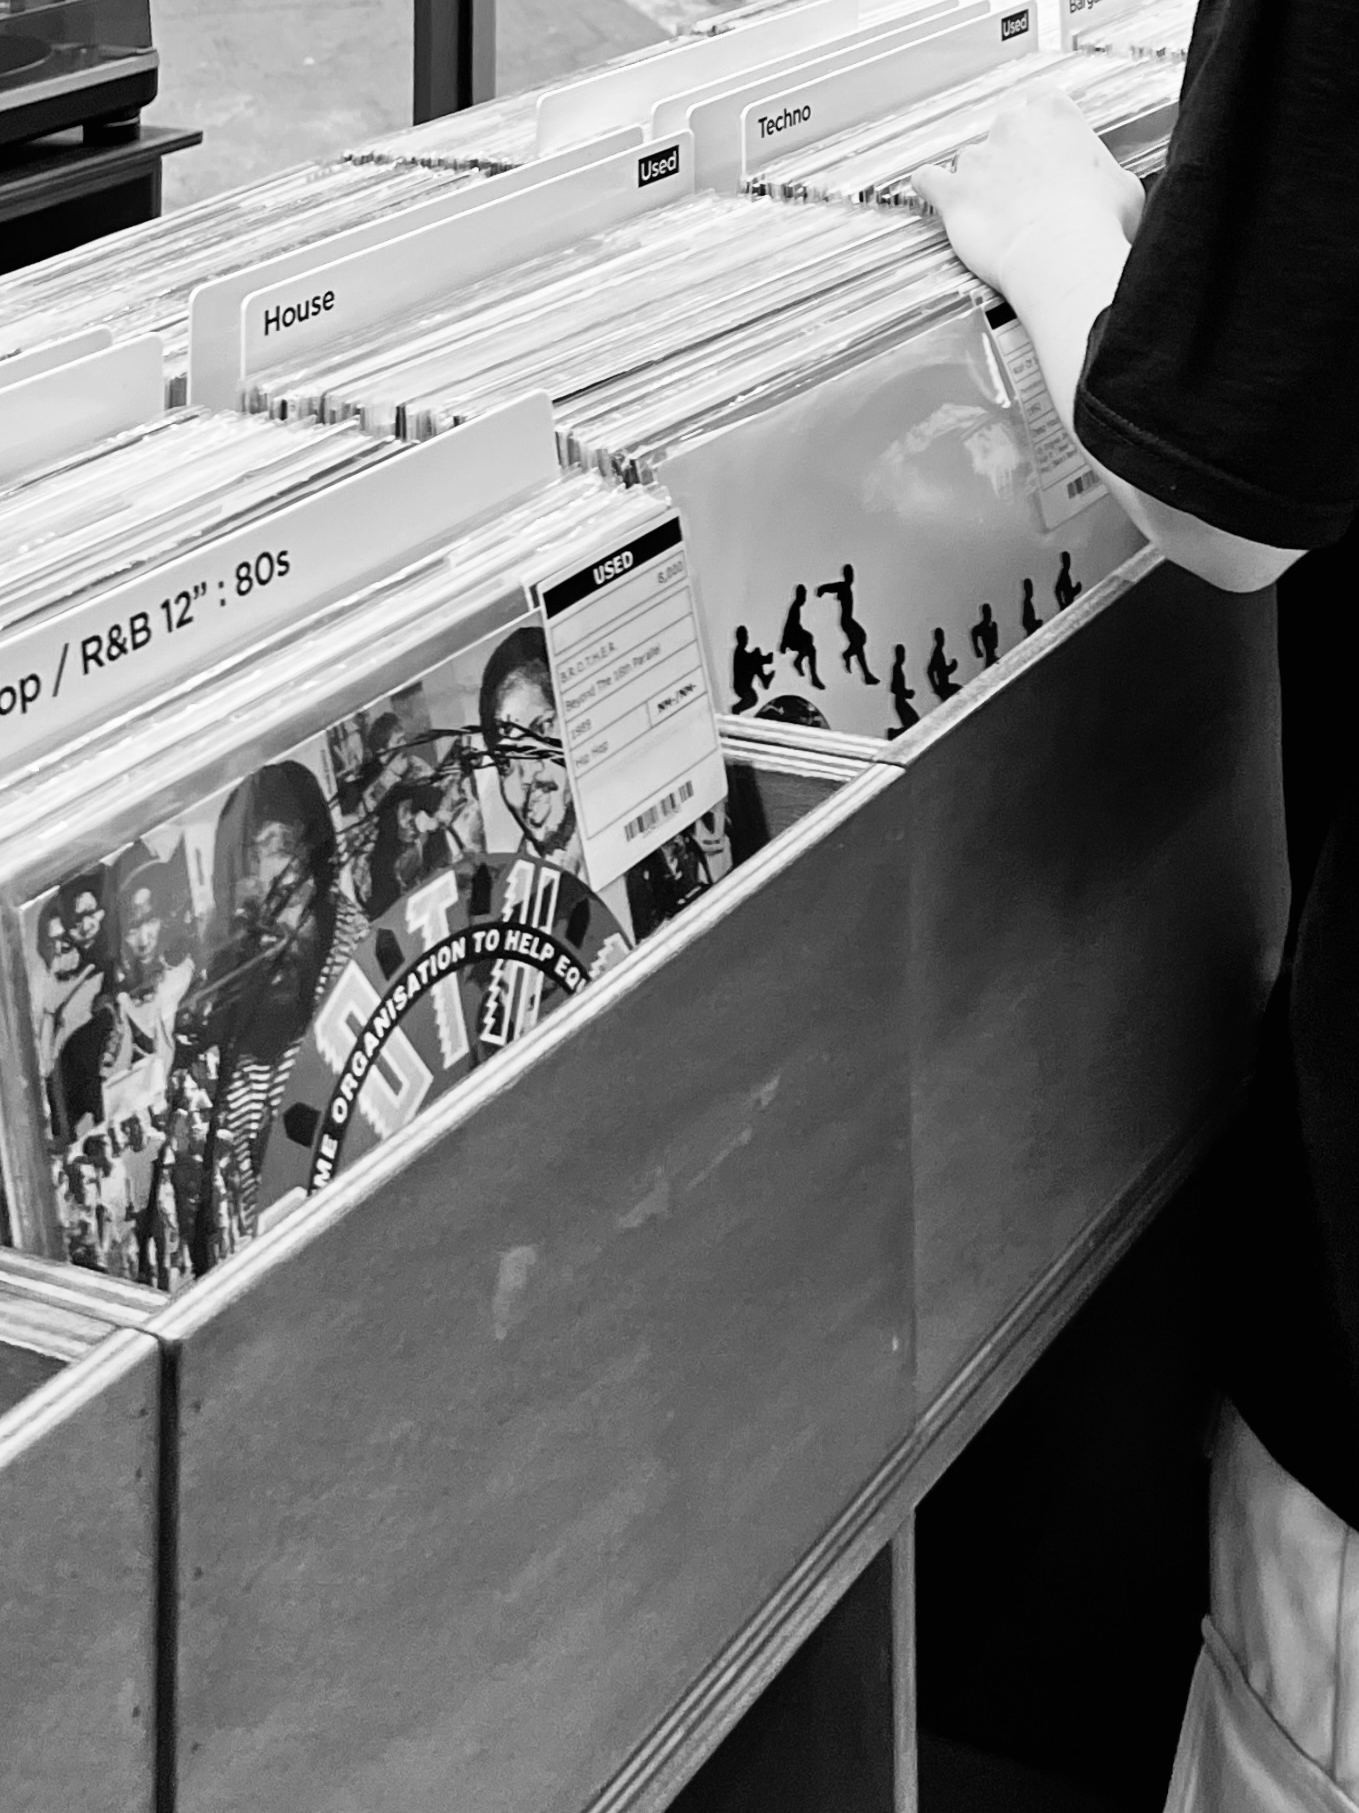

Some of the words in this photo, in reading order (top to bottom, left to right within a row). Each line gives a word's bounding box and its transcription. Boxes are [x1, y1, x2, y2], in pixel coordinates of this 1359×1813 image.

[1002, 14, 1028, 37] Used
[758, 105, 811, 138] Techno
[641, 150, 678, 181] Used
[264, 290, 336, 336] House
[592, 550, 634, 585] USED
[80, 611, 152, 676] R&B
[235, 550, 290, 596] 80s
[331, 936, 466, 1124] ORGANISATION
[472, 928, 501, 954] TO
[504, 929, 555, 962] HELP
